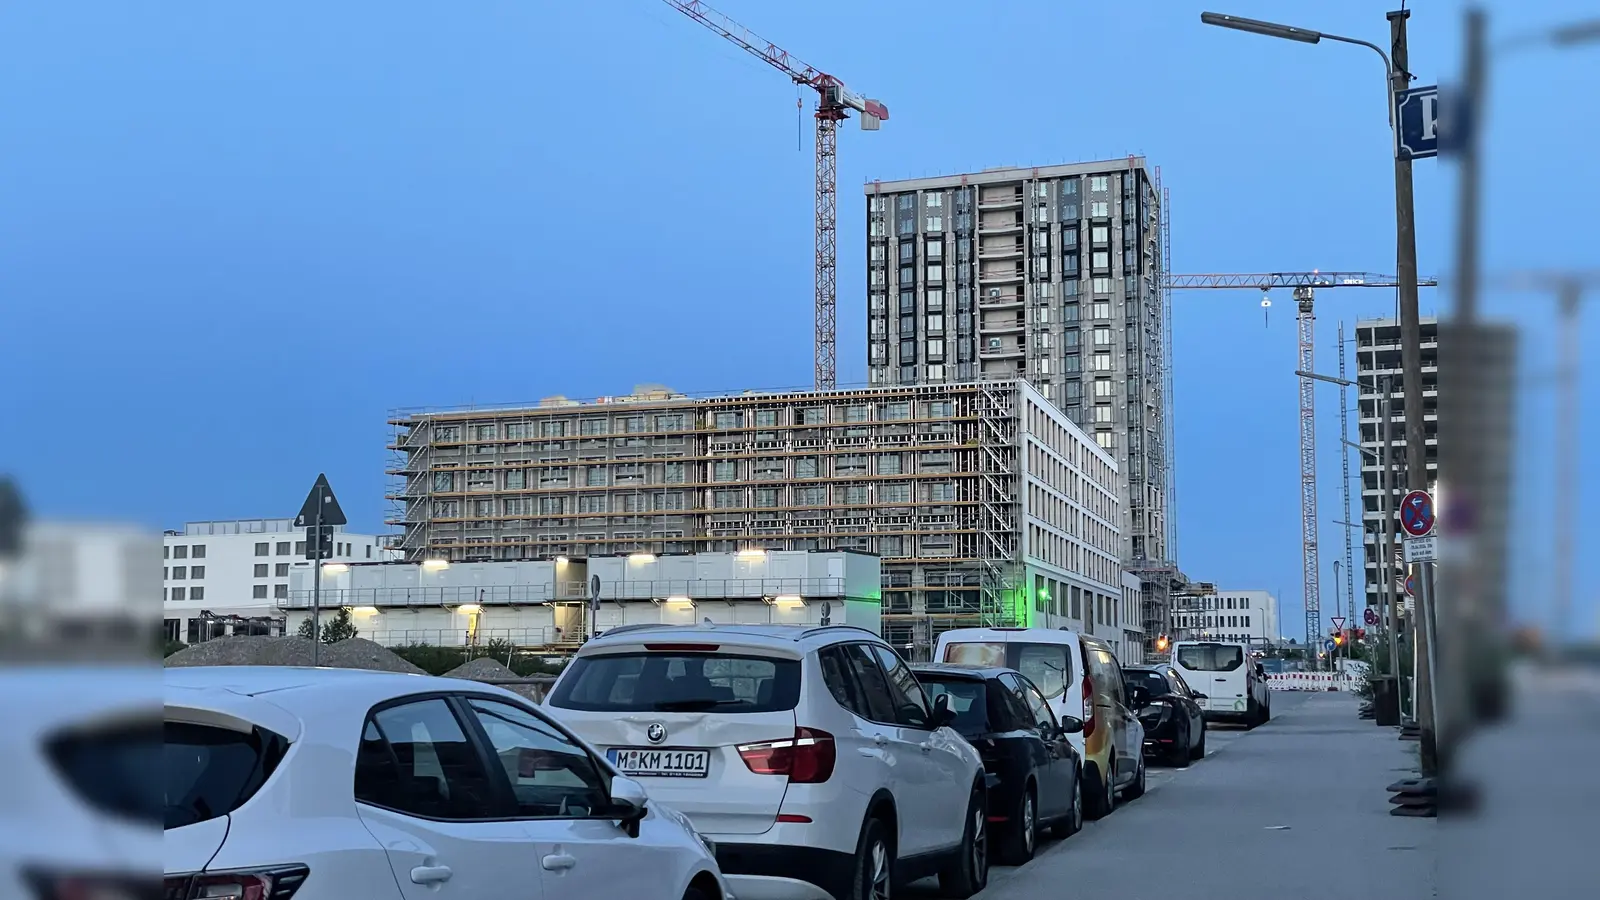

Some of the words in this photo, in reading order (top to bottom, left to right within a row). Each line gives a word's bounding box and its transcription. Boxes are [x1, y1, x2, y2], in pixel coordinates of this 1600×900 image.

[617, 751, 629, 769] M
[638, 752, 661, 769] KM
[663, 753, 704, 770] 1101
